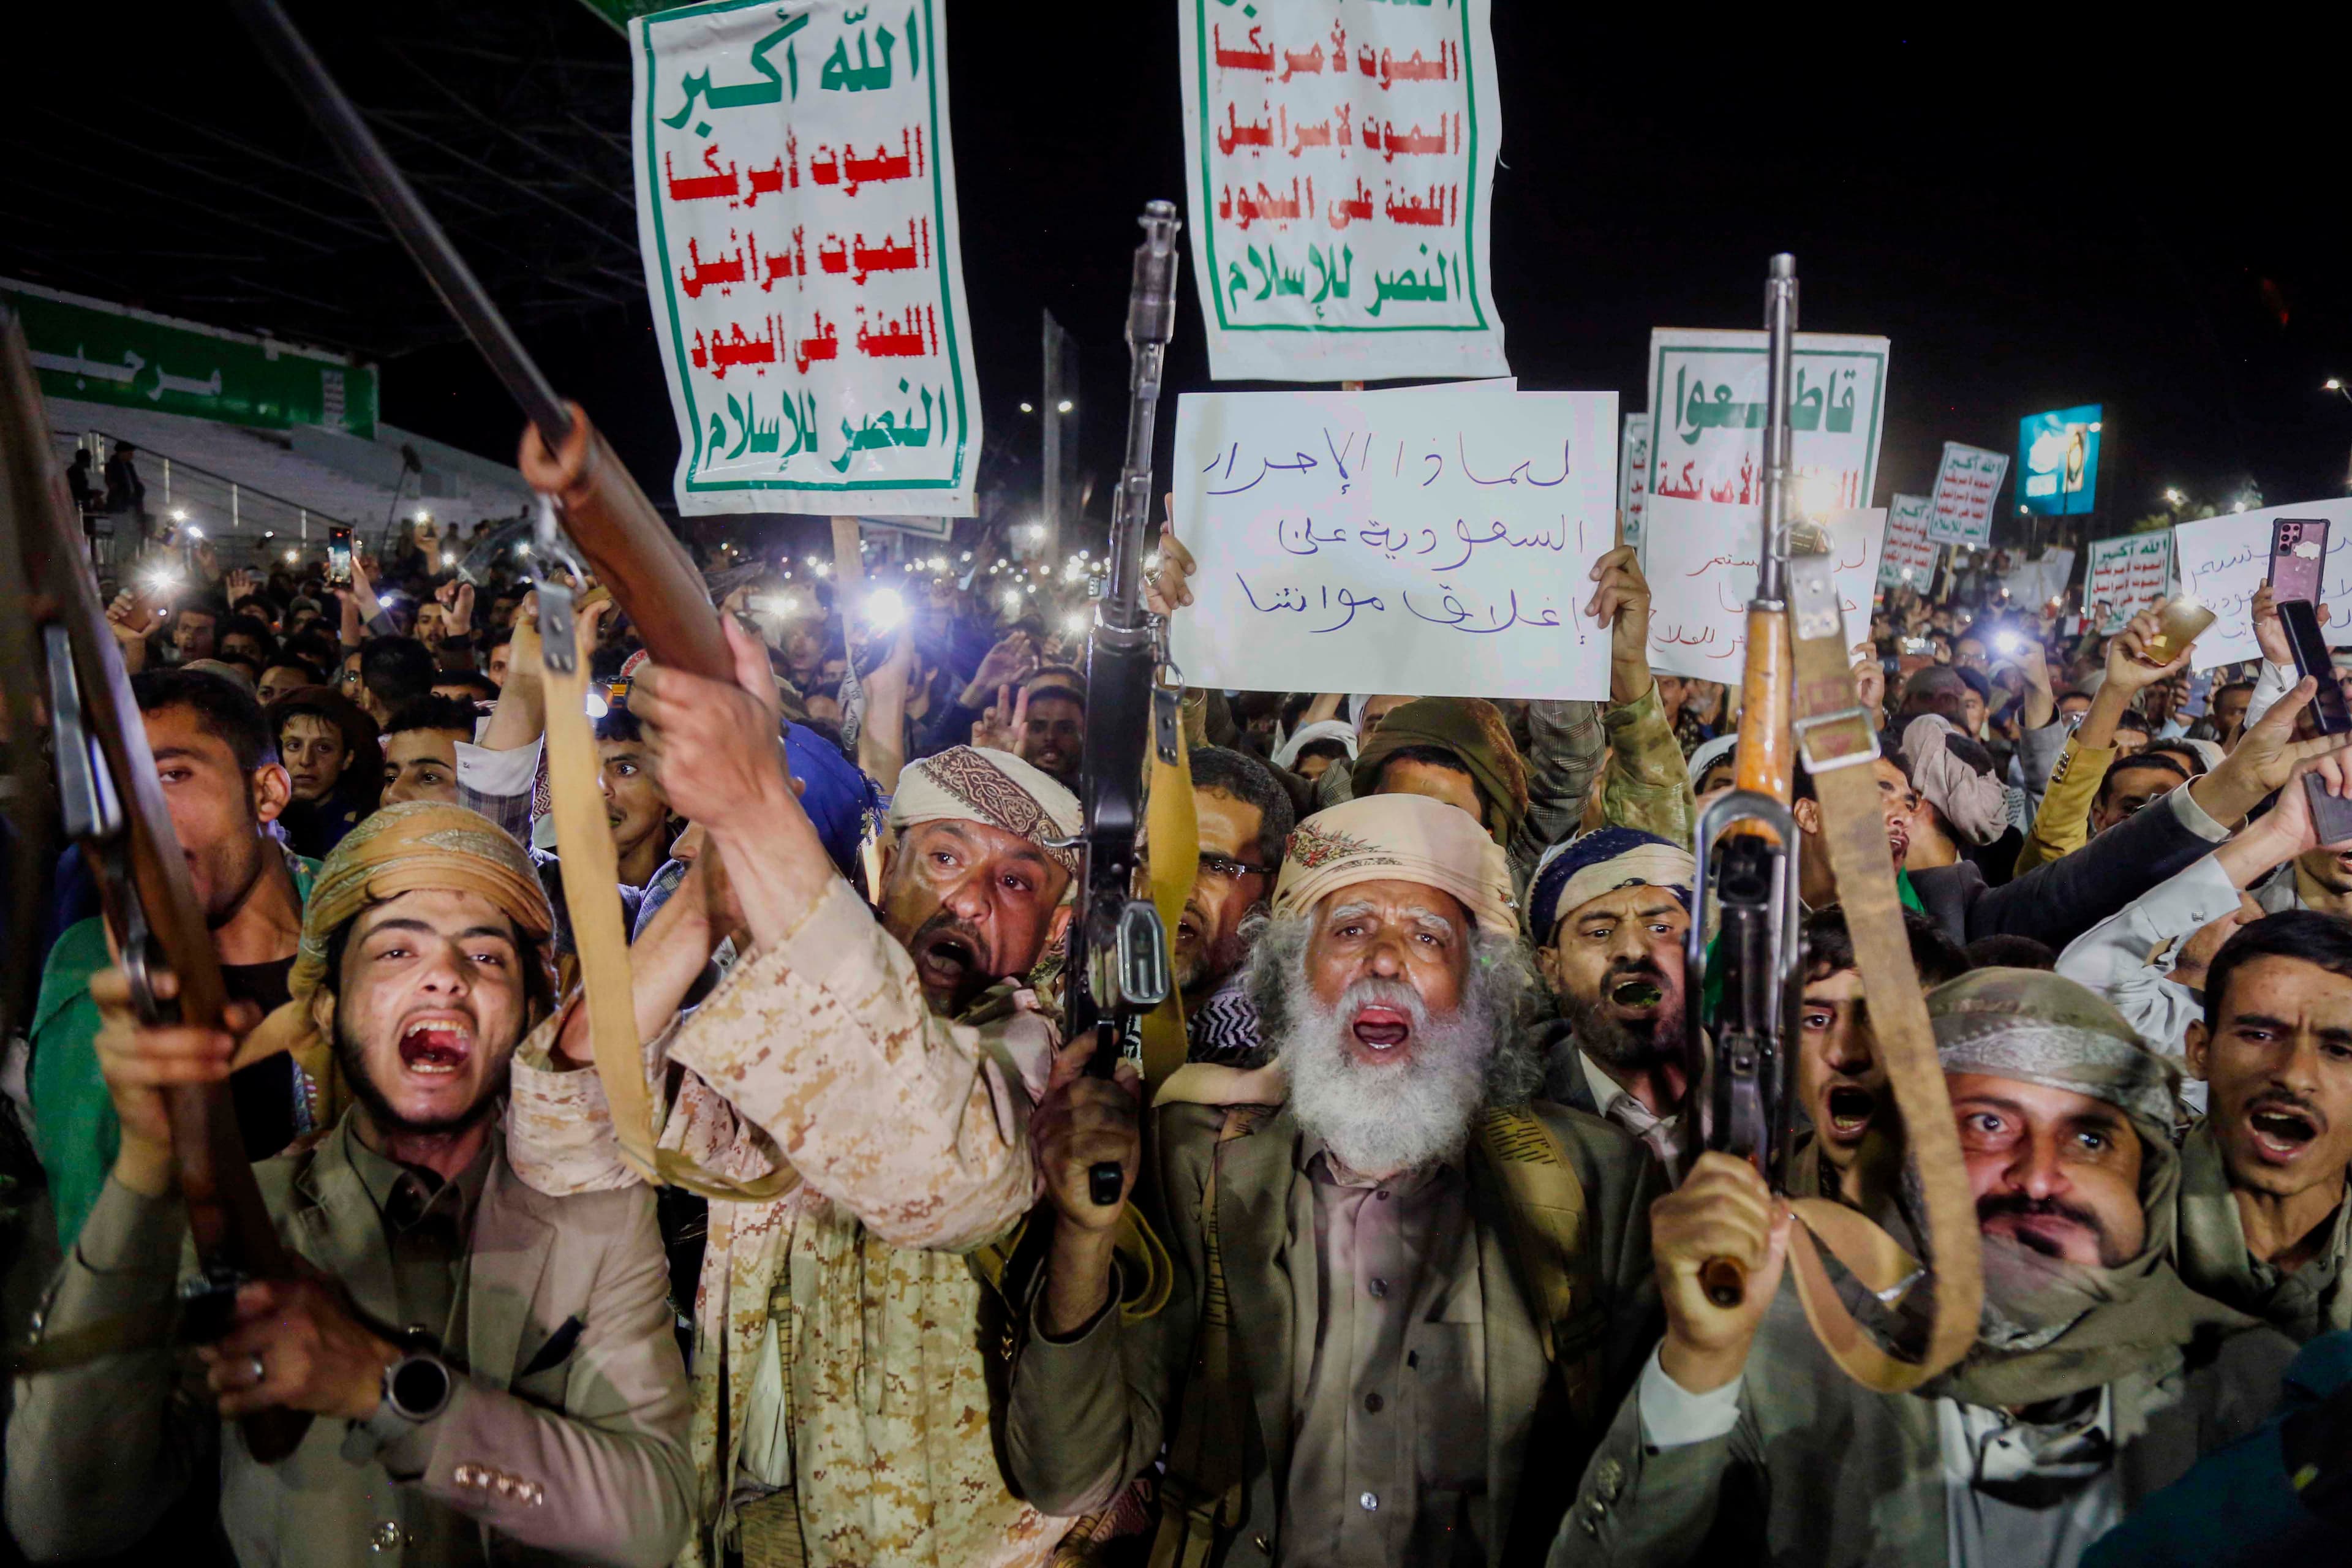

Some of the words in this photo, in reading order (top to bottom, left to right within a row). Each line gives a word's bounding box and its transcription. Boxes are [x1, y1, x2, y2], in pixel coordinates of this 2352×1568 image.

[660, 6, 809, 138] أكبر
[820, 6, 921, 93] الله
[1358, 39, 1458, 91] الموت
[810, 123, 924, 197] الموت
[1362, 111, 1460, 164] الموت
[1219, 175, 1315, 231] اليهود
[1328, 176, 1374, 230] على
[1385, 178, 1458, 227] اللعنة
[818, 215, 930, 286] الموت
[1229, 243, 1353, 319] للإسلام
[1365, 243, 1461, 317] النصر
[690, 312, 785, 380] اليهود
[794, 309, 839, 375] على
[856, 303, 938, 358] اللعنة
[706, 388, 818, 473] للإسلام
[830, 376, 949, 474] النصر
[1396, 432, 1569, 487] لماذا
[1359, 514, 1583, 571] السعودية
[1403, 584, 1586, 645] إغلاق
